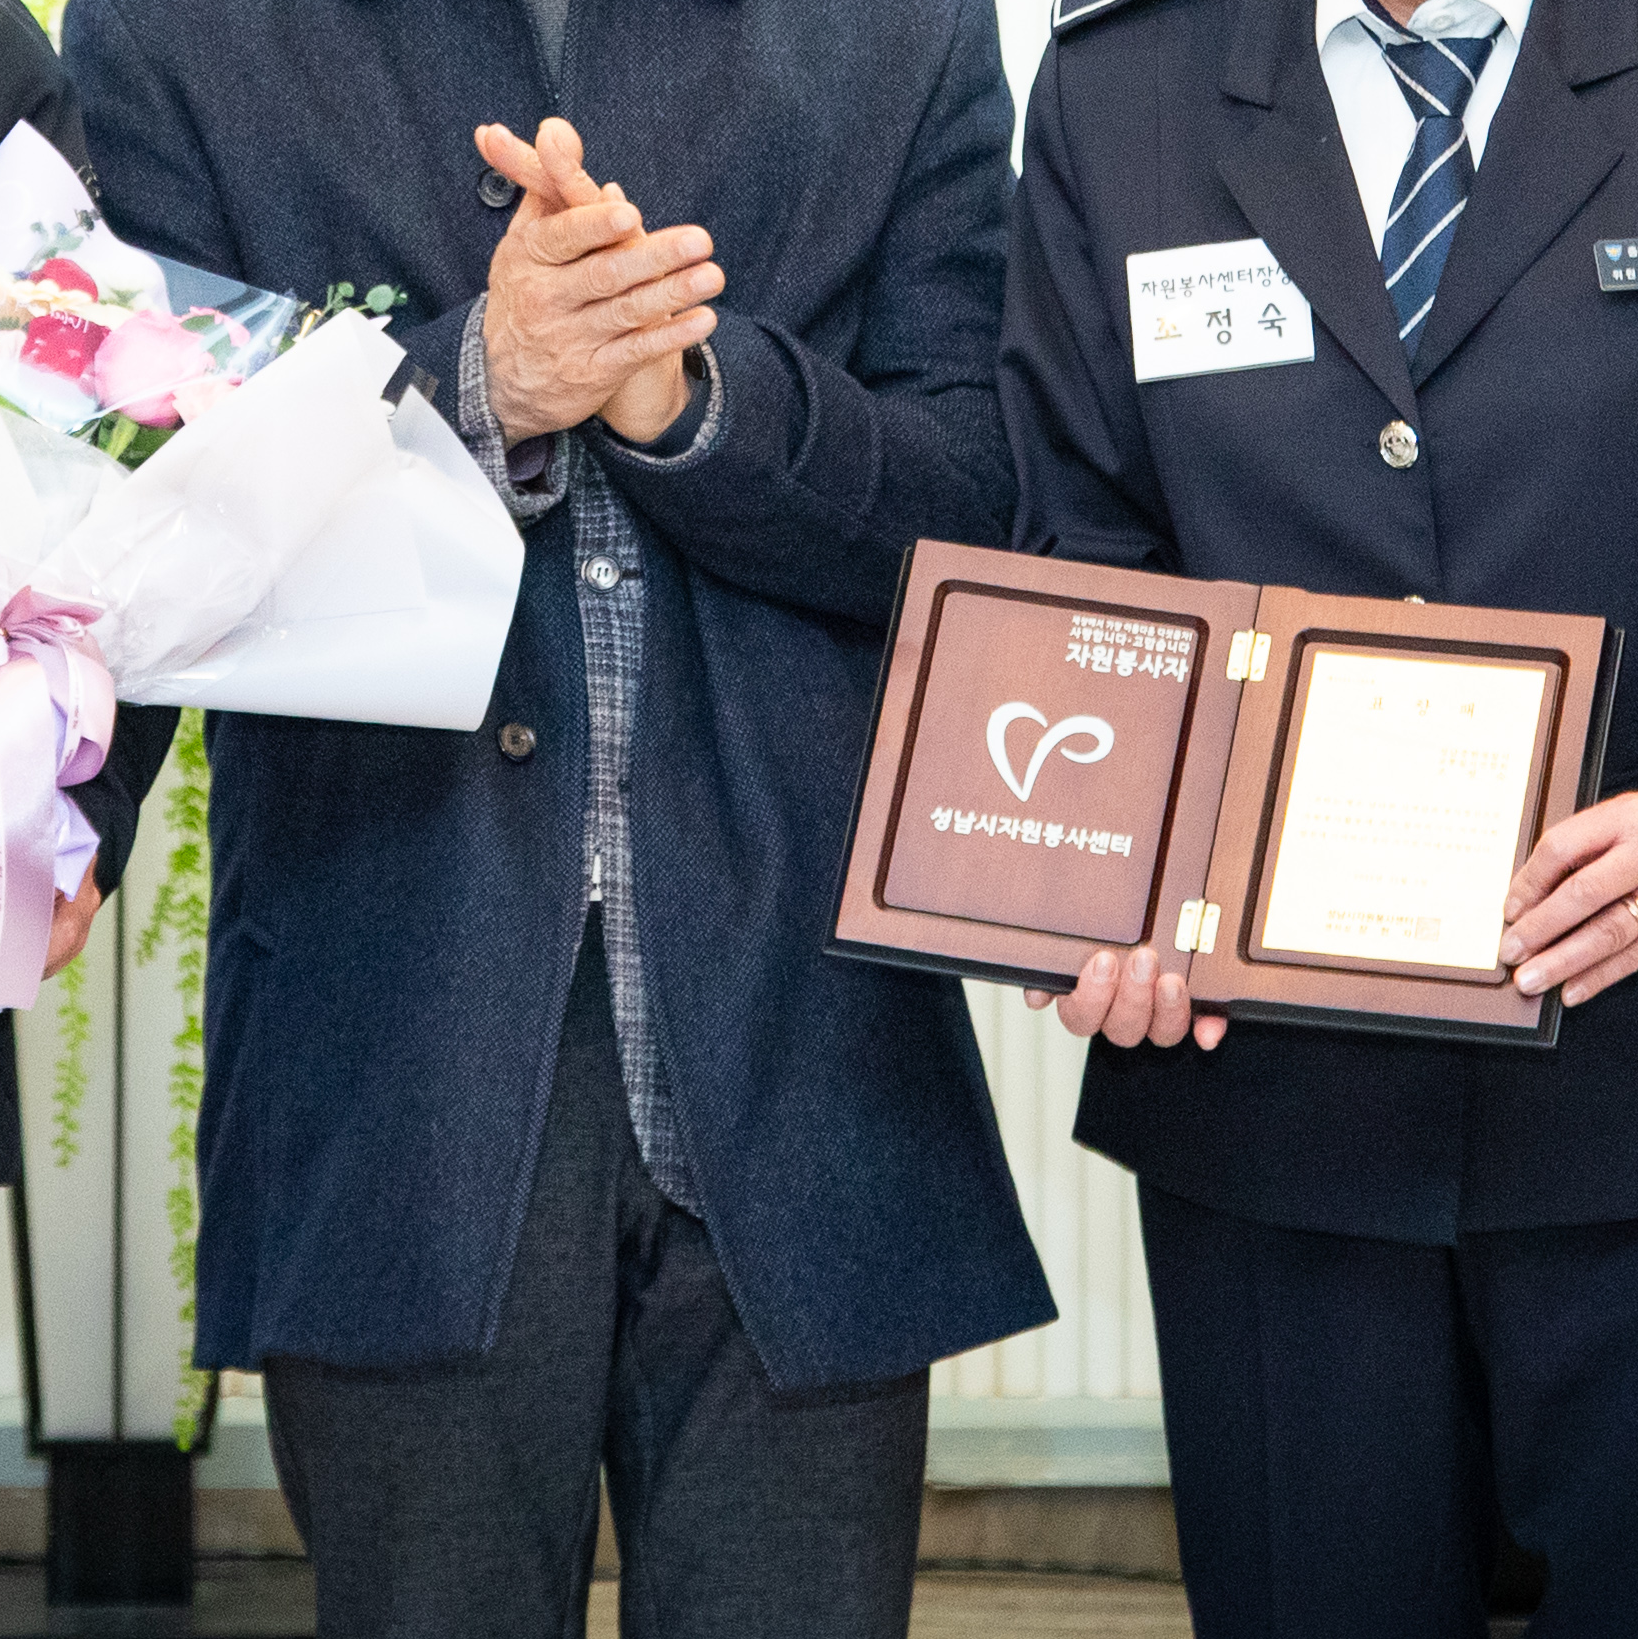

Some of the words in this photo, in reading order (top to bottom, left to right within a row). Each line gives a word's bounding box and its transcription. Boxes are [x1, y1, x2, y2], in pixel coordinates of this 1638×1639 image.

[1205, 308, 1233, 346] 정
[1257, 302, 1288, 339] 숙
[1065, 642, 1189, 683] 자원봉사자
[930, 806, 1133, 857] 성남시자원봉사센터
